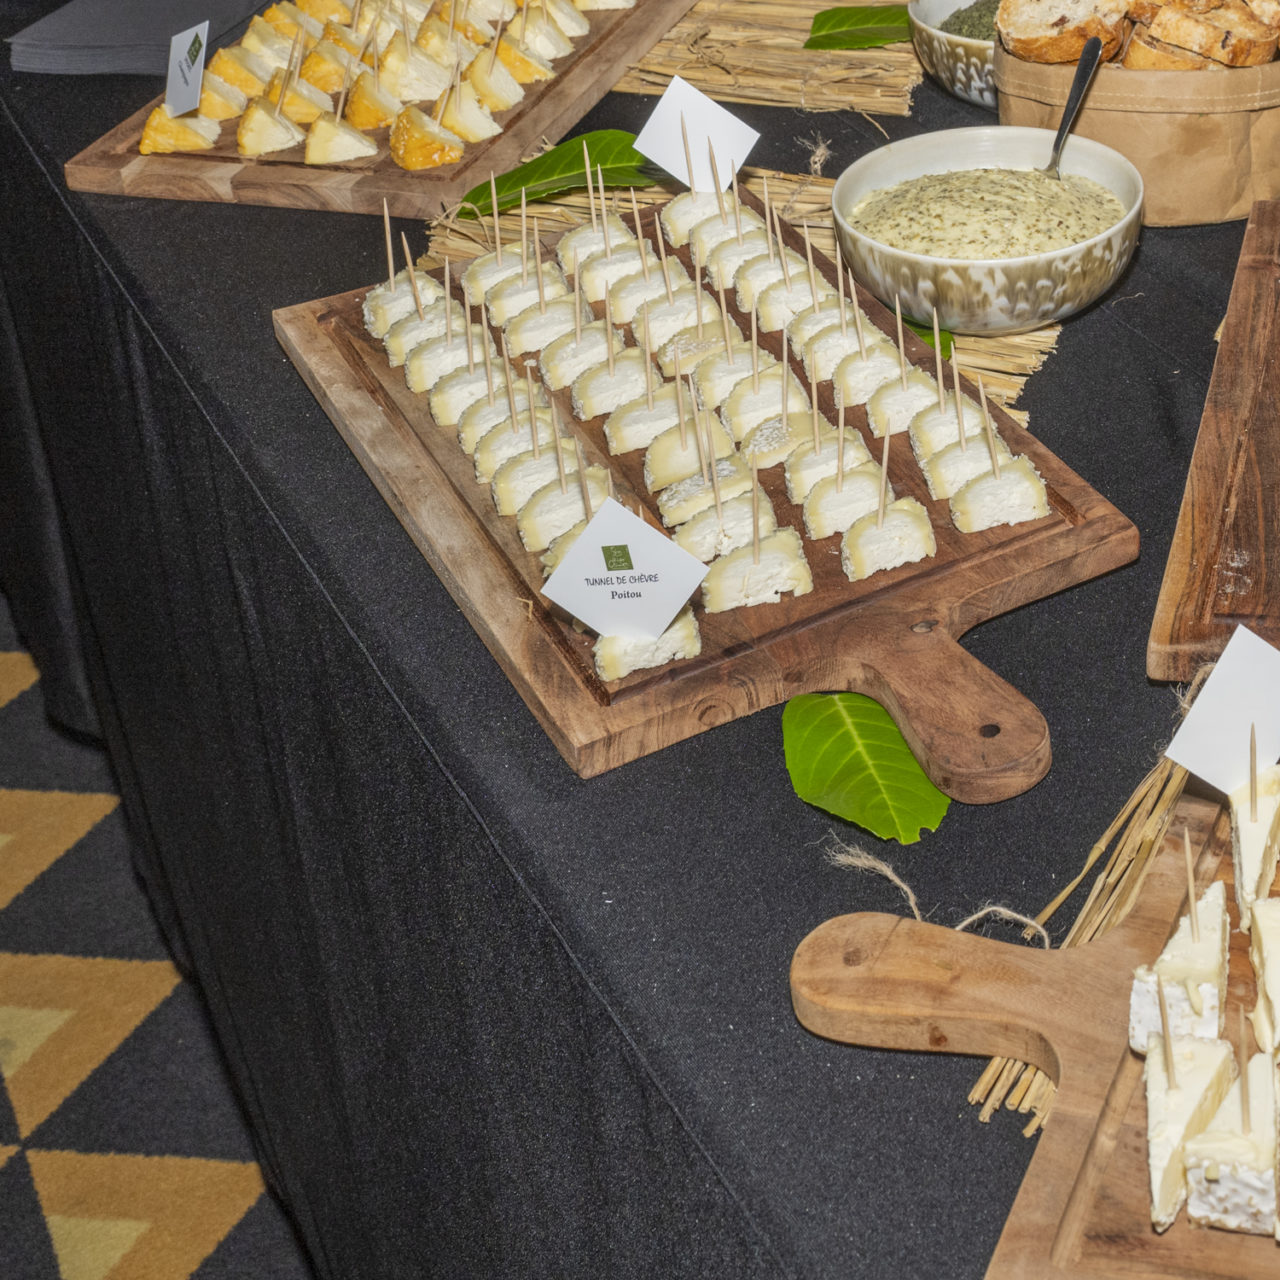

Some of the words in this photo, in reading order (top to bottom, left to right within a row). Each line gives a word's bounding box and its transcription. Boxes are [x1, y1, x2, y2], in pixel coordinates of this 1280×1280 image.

[584, 576, 615, 587] TUNNEL
[616, 575, 628, 585] DE
[611, 590, 642, 600] Poitou
